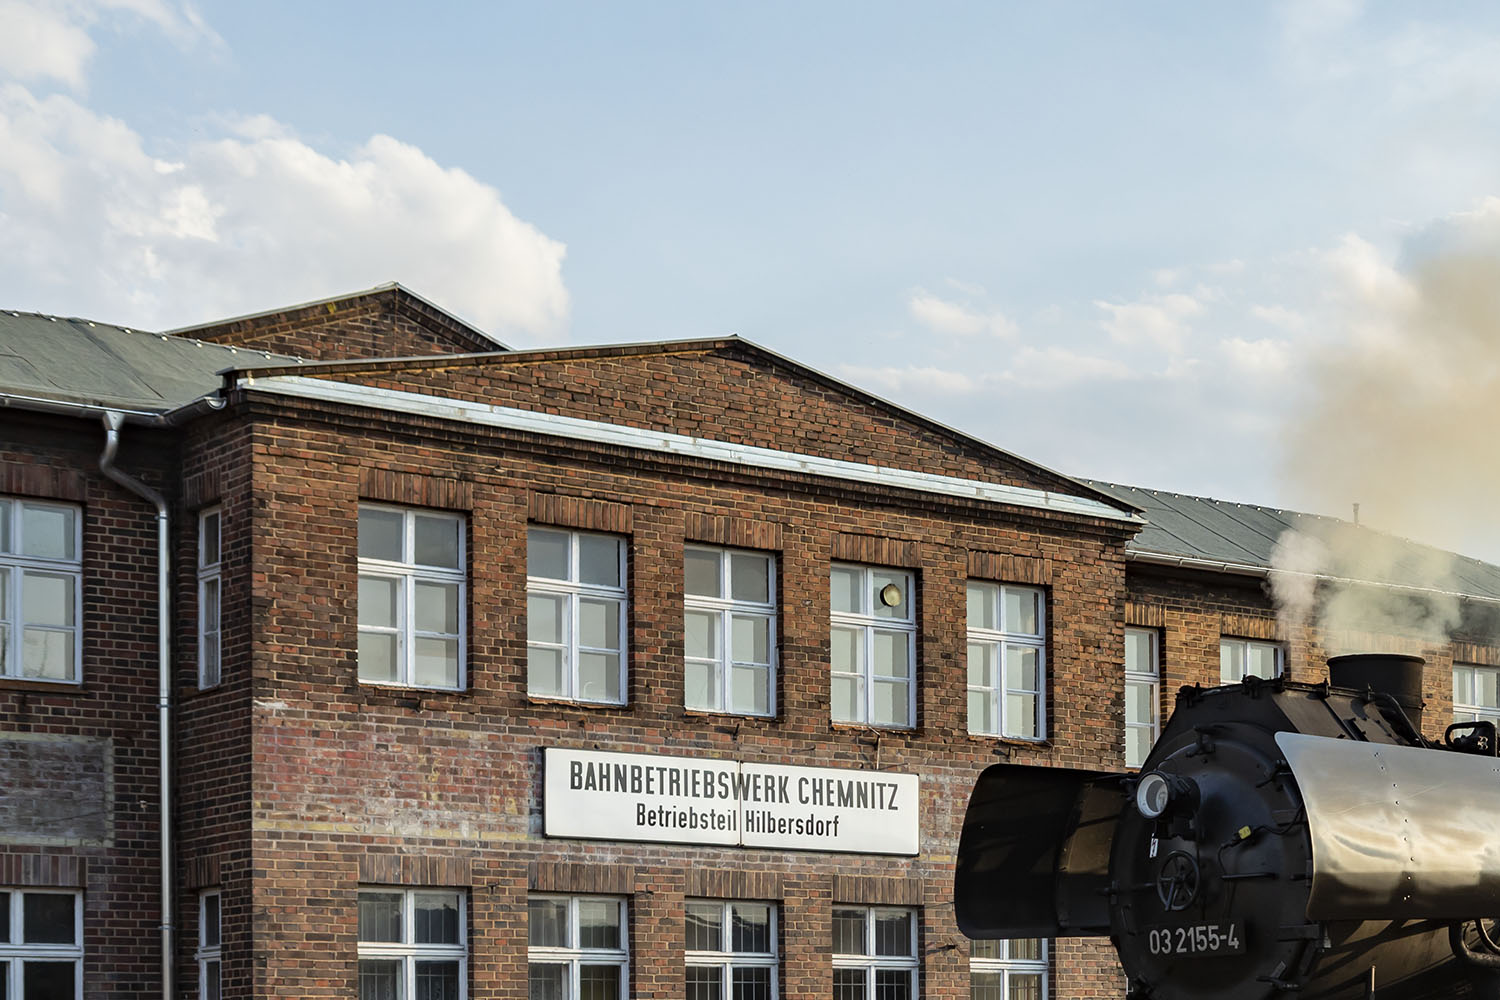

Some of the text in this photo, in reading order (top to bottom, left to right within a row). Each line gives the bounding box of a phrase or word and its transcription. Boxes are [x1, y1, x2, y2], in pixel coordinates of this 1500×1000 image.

[570, 761, 899, 810] BAHNBETRIEBSWERK CHEMNITZ
[637, 803, 839, 837] Betriebsteil Hilbersdorf
[1150, 924, 1239, 954] 03 2155-4
